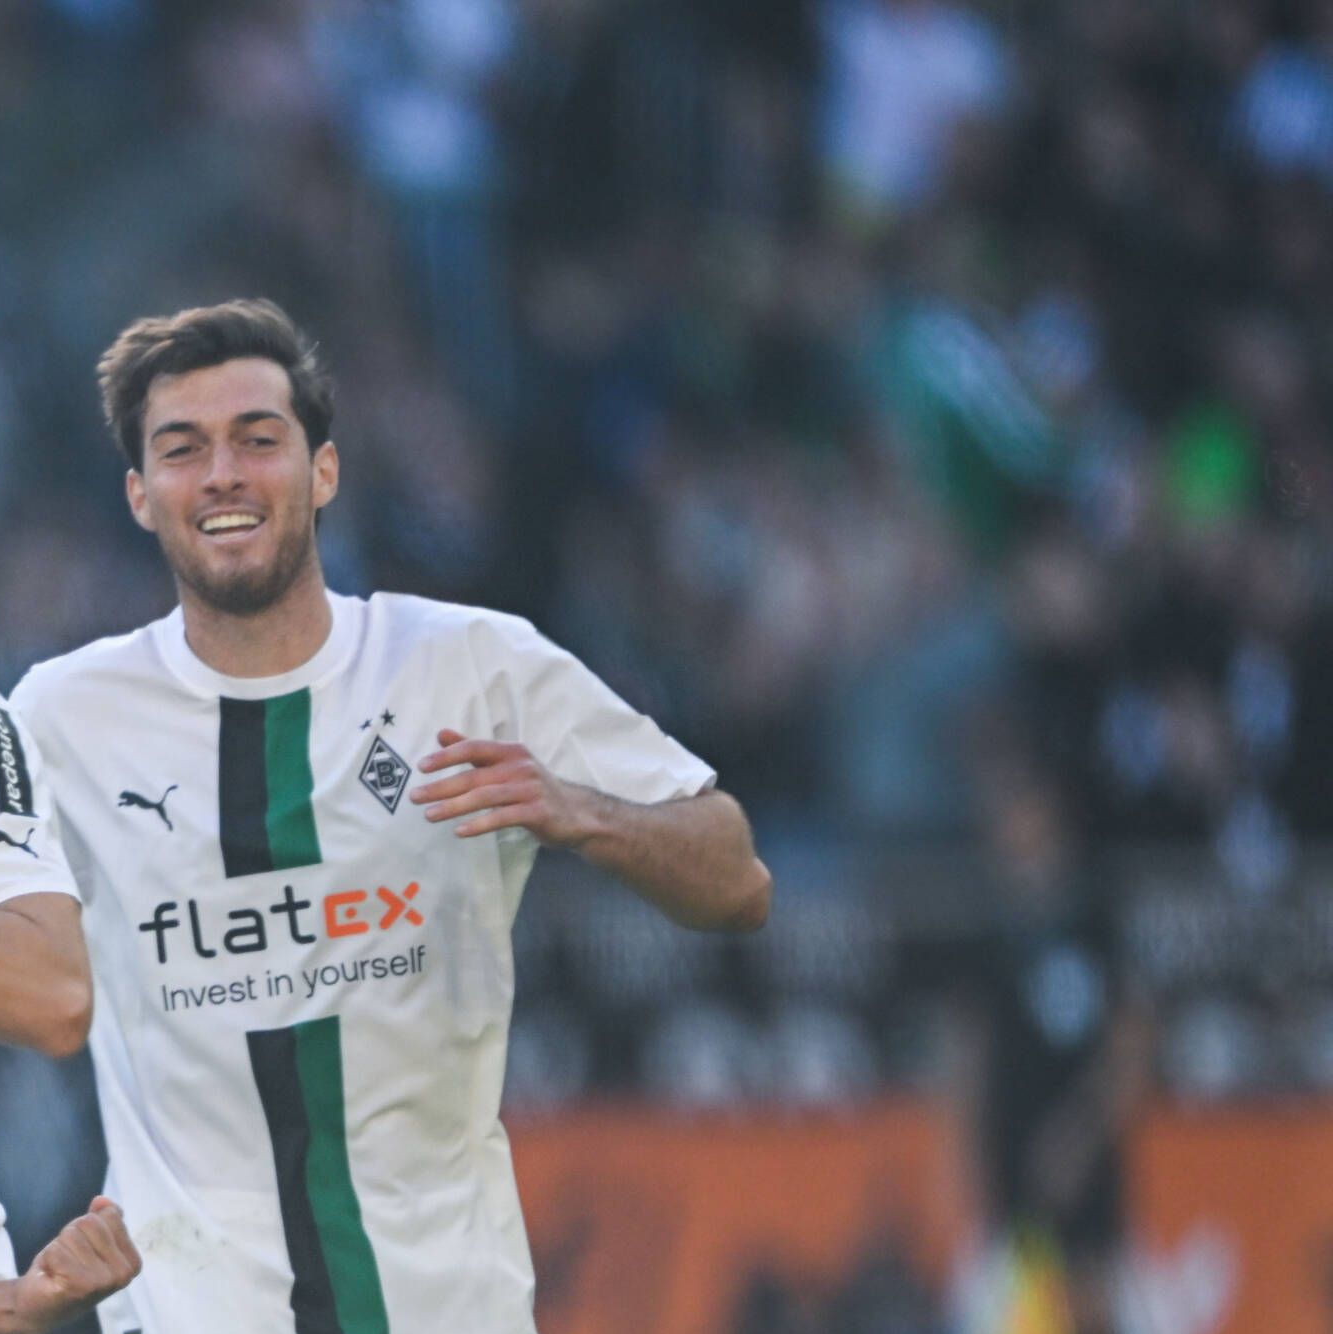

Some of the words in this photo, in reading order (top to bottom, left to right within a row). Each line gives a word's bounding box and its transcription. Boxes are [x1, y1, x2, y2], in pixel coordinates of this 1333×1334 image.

[162, 974, 258, 1011] Invest
[266, 970, 294, 997] in
[302, 944, 427, 998] yourself
